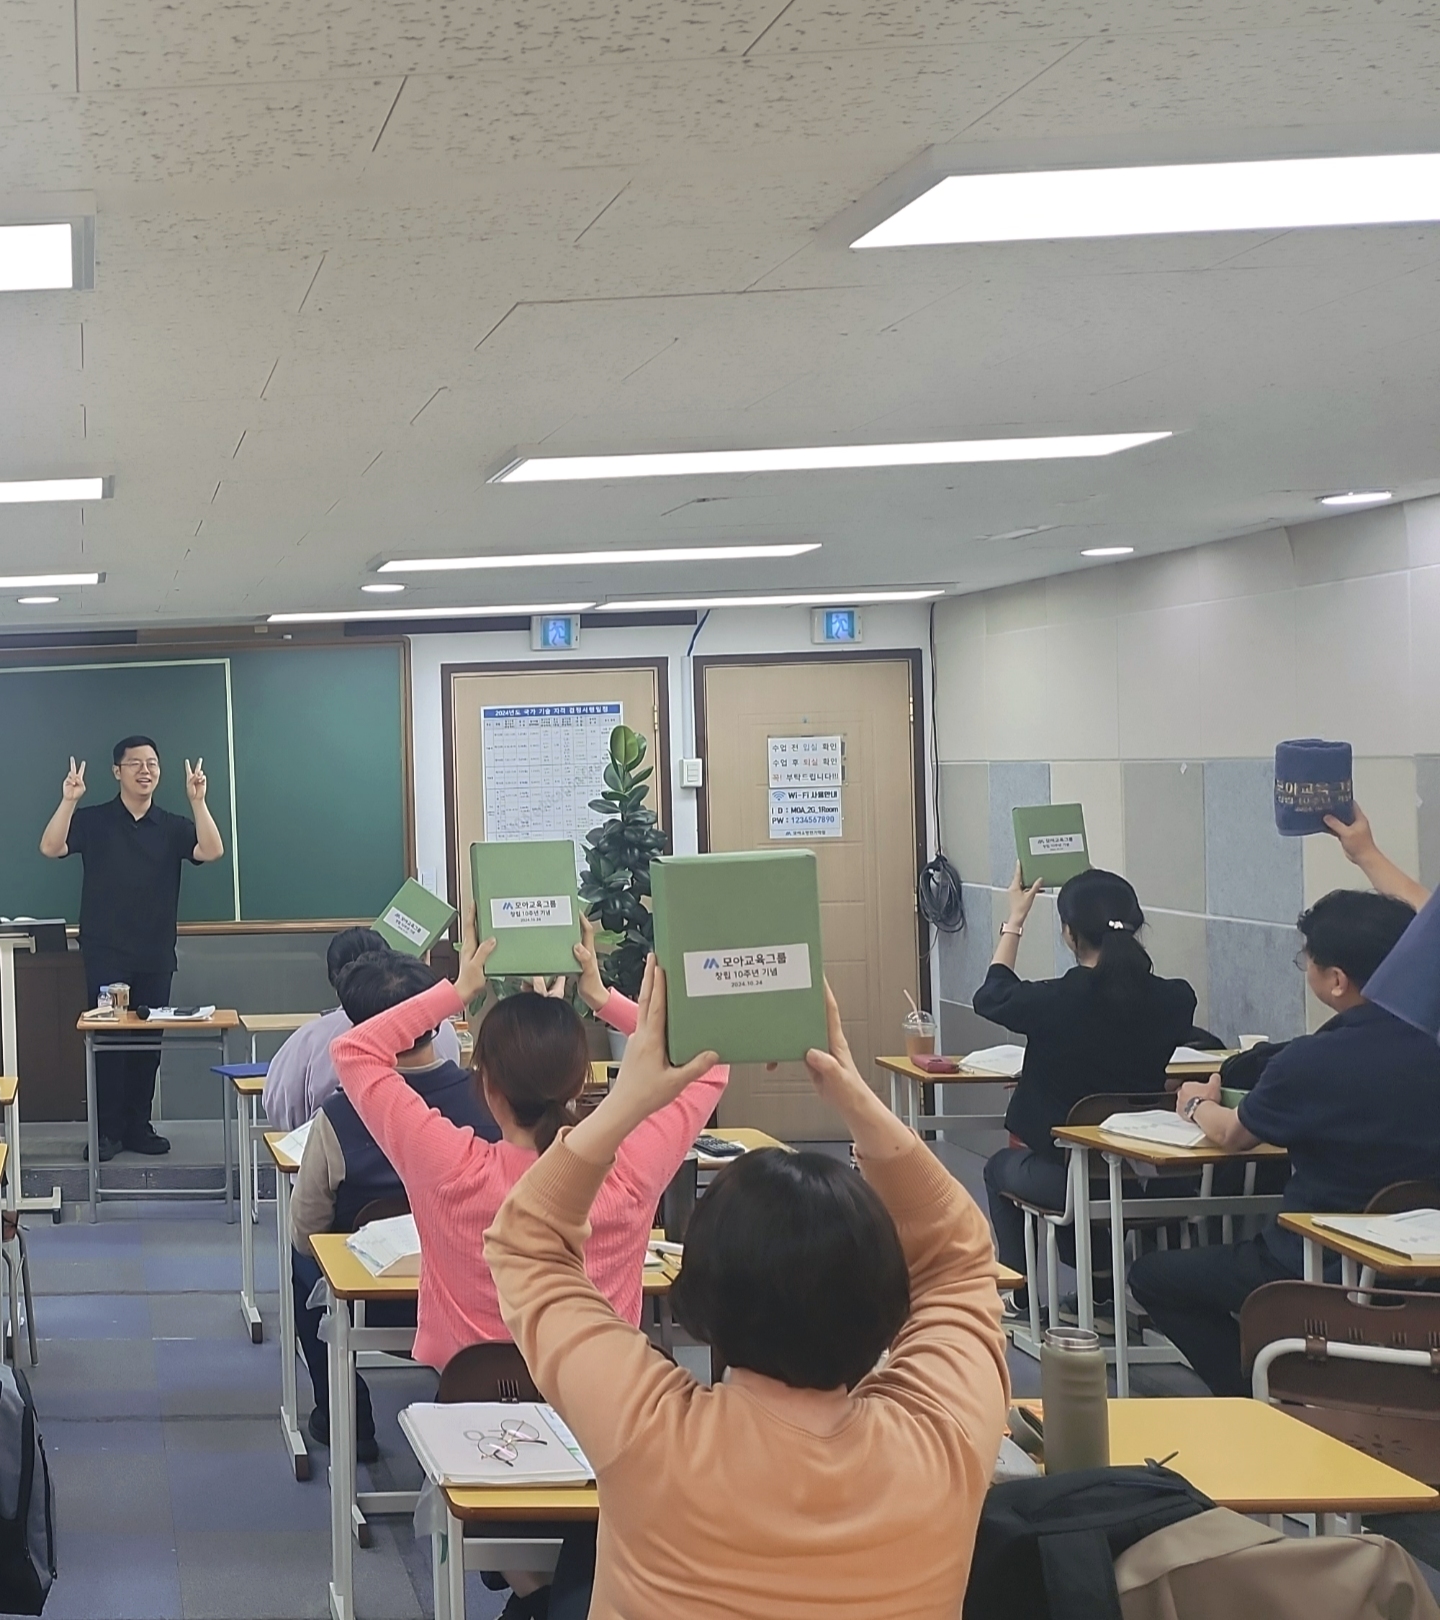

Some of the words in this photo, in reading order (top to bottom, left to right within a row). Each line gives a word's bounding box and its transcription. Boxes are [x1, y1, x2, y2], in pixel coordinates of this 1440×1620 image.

[772, 744, 787, 752] 수업
[792, 744, 799, 752] 전
[803, 744, 818, 752] 입실
[822, 743, 837, 751] 확인
[773, 759, 788, 767] 수업
[792, 759, 799, 767] 후
[804, 759, 818, 767] 퇴실
[823, 758, 838, 766] 확인
[792, 816, 835, 824] 1234567890
[515, 900, 556, 910] 모아교육그룹
[722, 952, 786, 967] 모아교육그룹
[715, 972, 731, 980] 창립
[734, 969, 759, 979] 10주년
[762, 967, 778, 977] 기념
